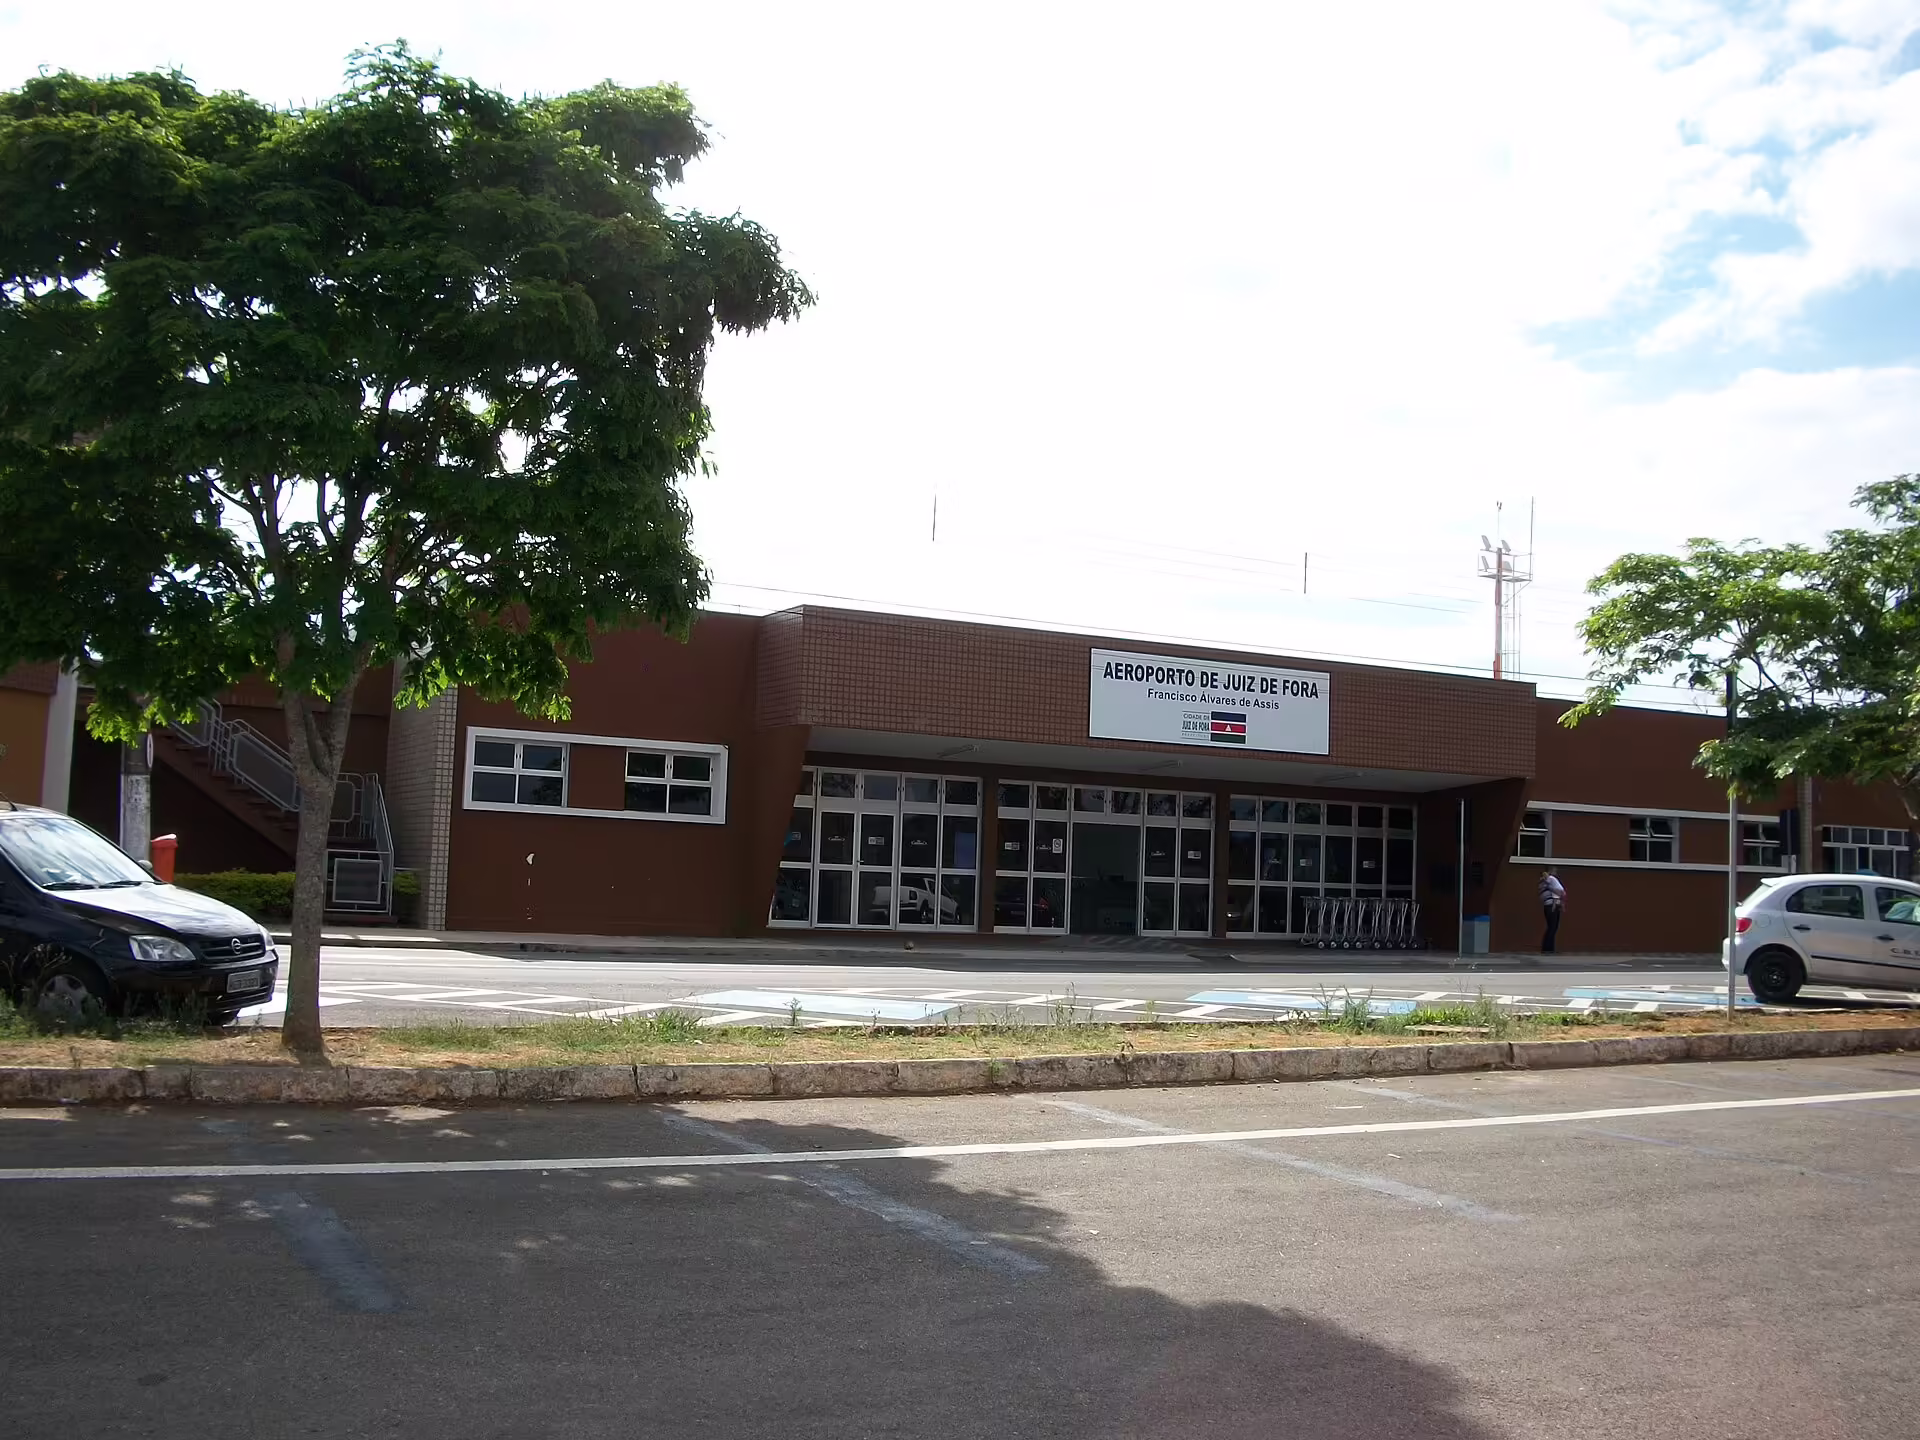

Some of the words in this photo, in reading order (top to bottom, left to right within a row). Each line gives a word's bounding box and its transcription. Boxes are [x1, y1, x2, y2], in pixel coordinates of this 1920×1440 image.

[1103, 661, 1196, 687] AEROPORTO
[1200, 671, 1219, 690] DE
[1223, 673, 1256, 693] JUIZ
[1260, 676, 1278, 695] DE
[1282, 679, 1319, 699] FORA
[1147, 688, 1197, 703] Francisco
[1200, 690, 1237, 706] Álvares
[1239, 697, 1251, 708] de
[1253, 698, 1280, 710] Assis
[1182, 720, 1191, 730] JUIZ
[1192, 721, 1198, 731] DE
[1198, 721, 1210, 732] FORA
